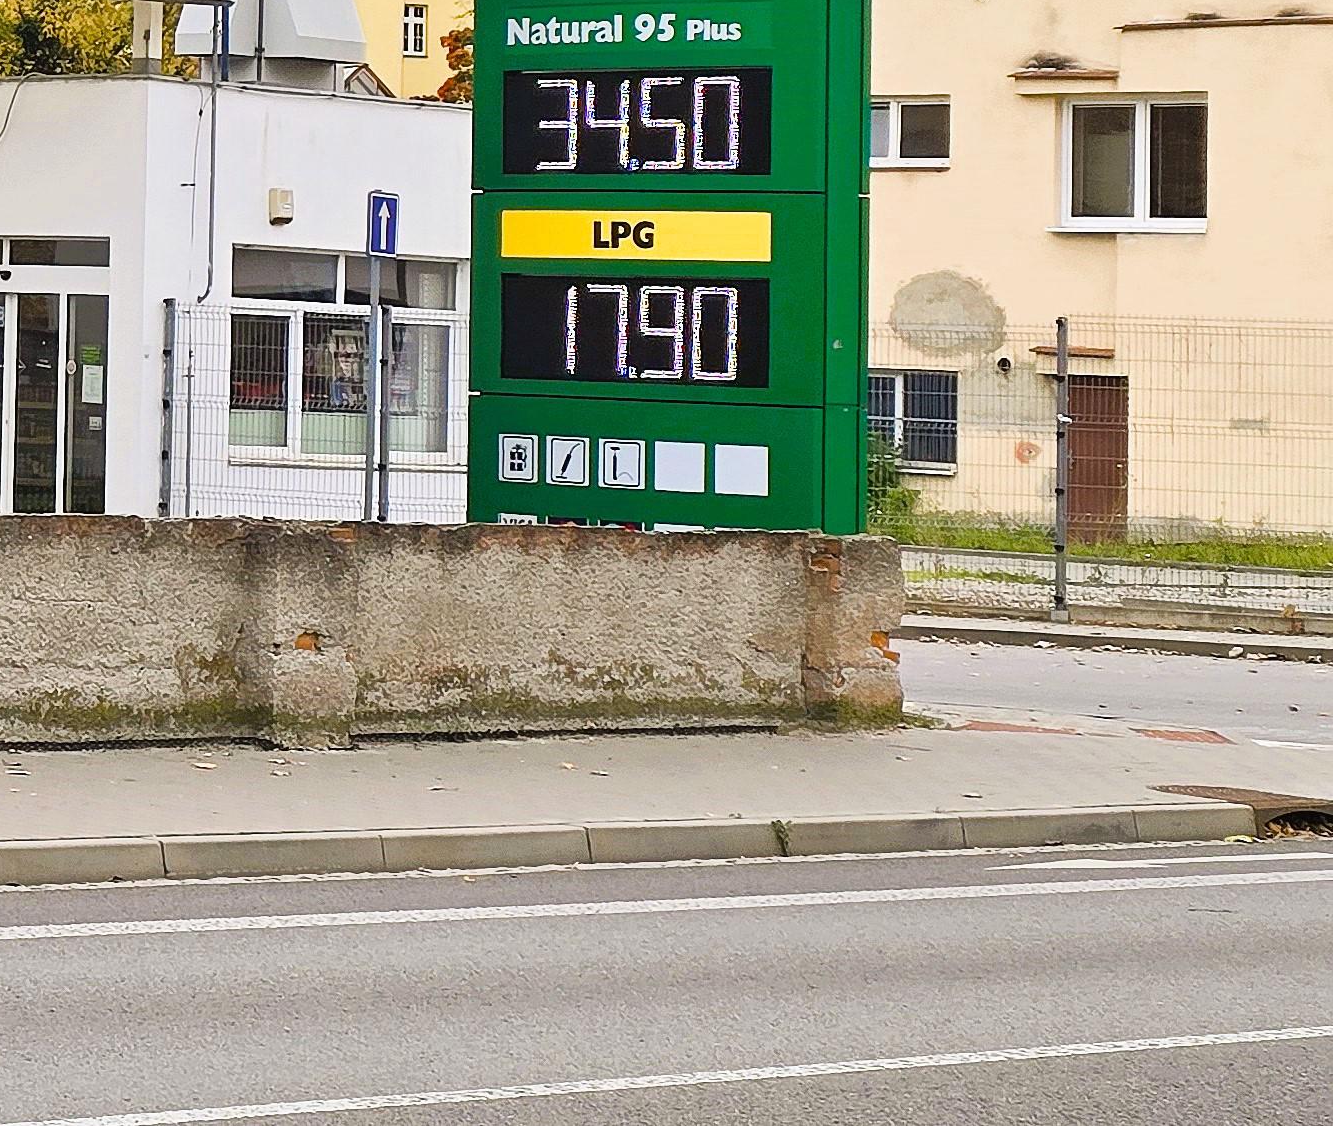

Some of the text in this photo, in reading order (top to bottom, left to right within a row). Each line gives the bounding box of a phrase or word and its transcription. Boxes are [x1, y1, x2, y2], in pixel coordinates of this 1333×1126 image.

[506, 12, 743, 46] Natural 95 Plus
[534, 75, 742, 171] 34.50
[593, 220, 656, 249] LPG
[565, 283, 739, 381] 17.90
